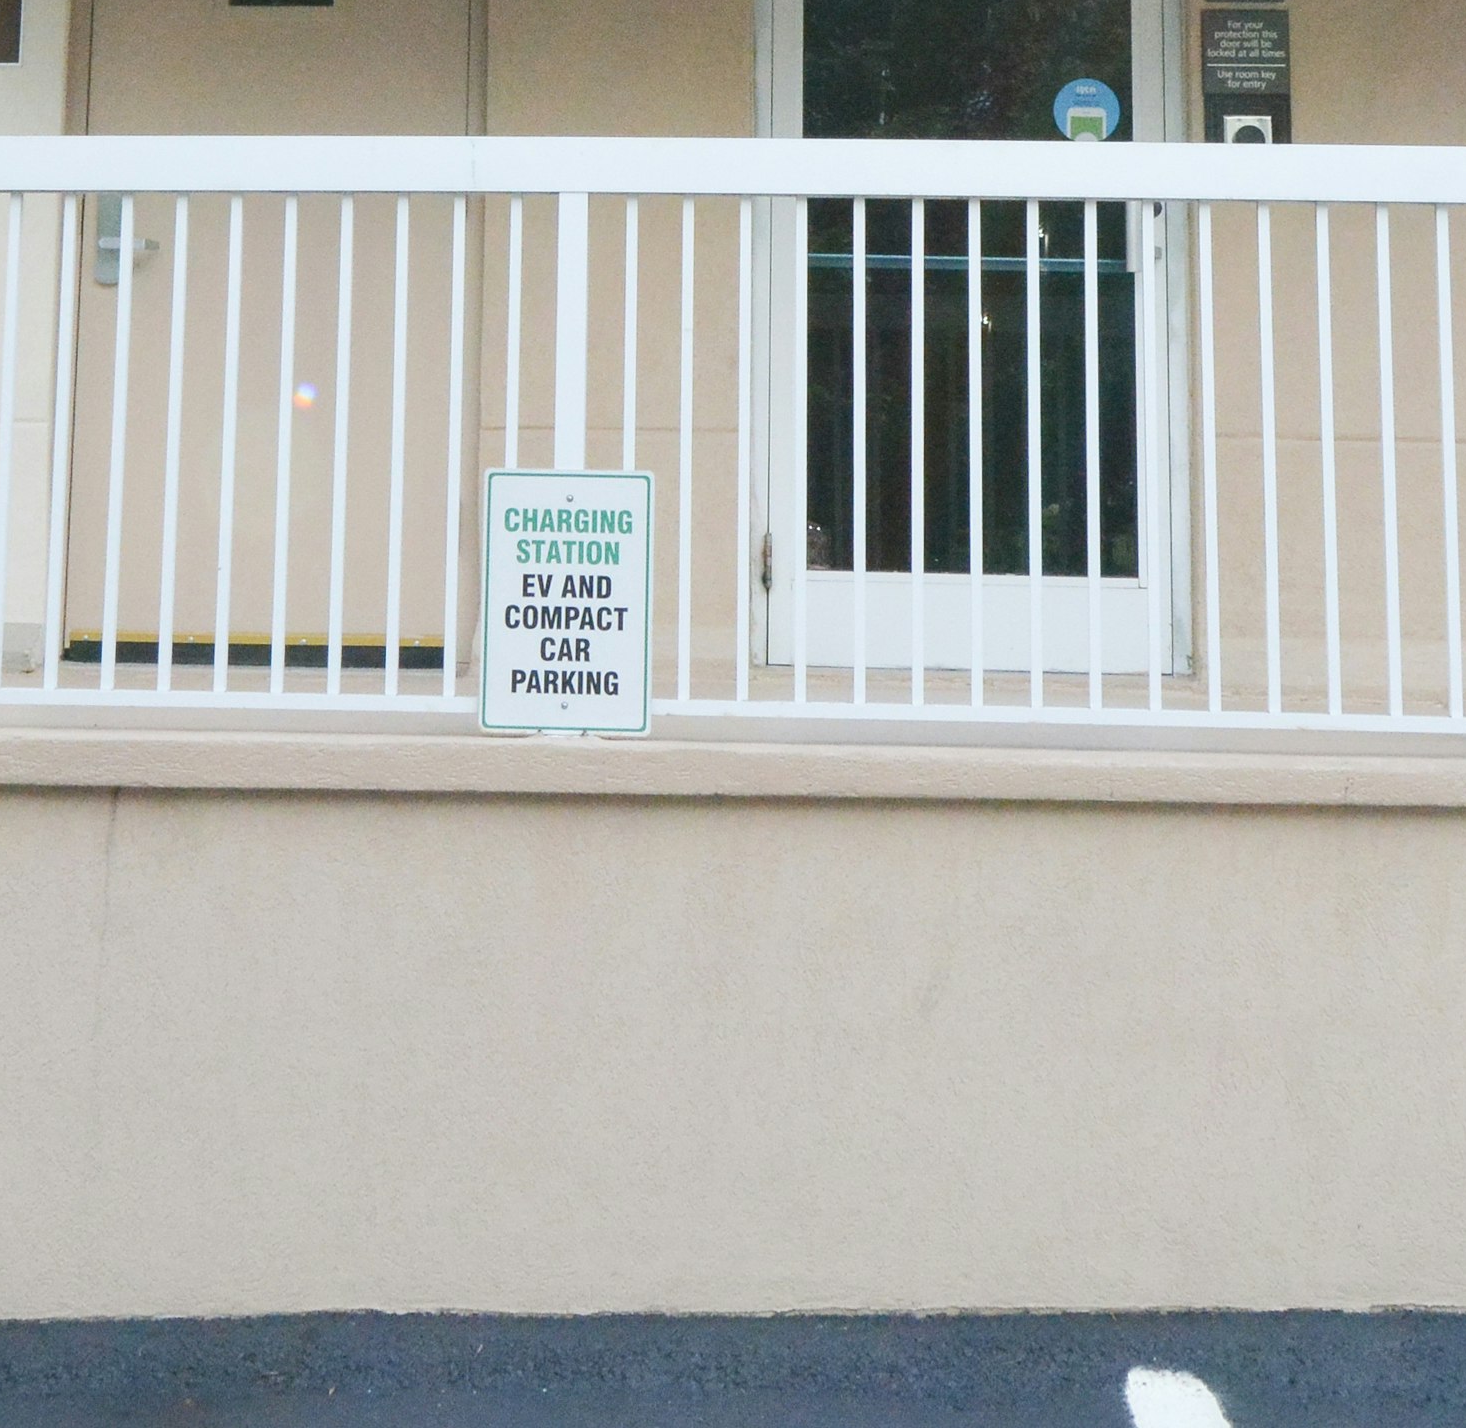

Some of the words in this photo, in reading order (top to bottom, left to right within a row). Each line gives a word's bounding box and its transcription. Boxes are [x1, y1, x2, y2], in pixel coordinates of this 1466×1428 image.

[1228, 21, 1241, 29] For
[1244, 22, 1263, 30] your
[1214, 30, 1259, 39] protection
[1263, 30, 1278, 38] this
[1220, 40, 1241, 48] door
[1243, 40, 1258, 48] will
[1261, 40, 1272, 48] be
[1207, 49, 1235, 57] locked
[1249, 49, 1259, 57] all
[1262, 49, 1285, 57] times
[1217, 70, 1233, 78] Use
[1262, 70, 1276, 80] key
[1228, 80, 1241, 88] for
[1243, 80, 1266, 89] entry
[504, 508, 632, 534] CHARGING
[516, 539, 620, 564] STATION
[522, 574, 552, 597] EV
[562, 575, 611, 599] AND
[505, 605, 628, 631] COMPACT
[540, 637, 590, 662] CAR
[511, 669, 618, 695] PARKING
